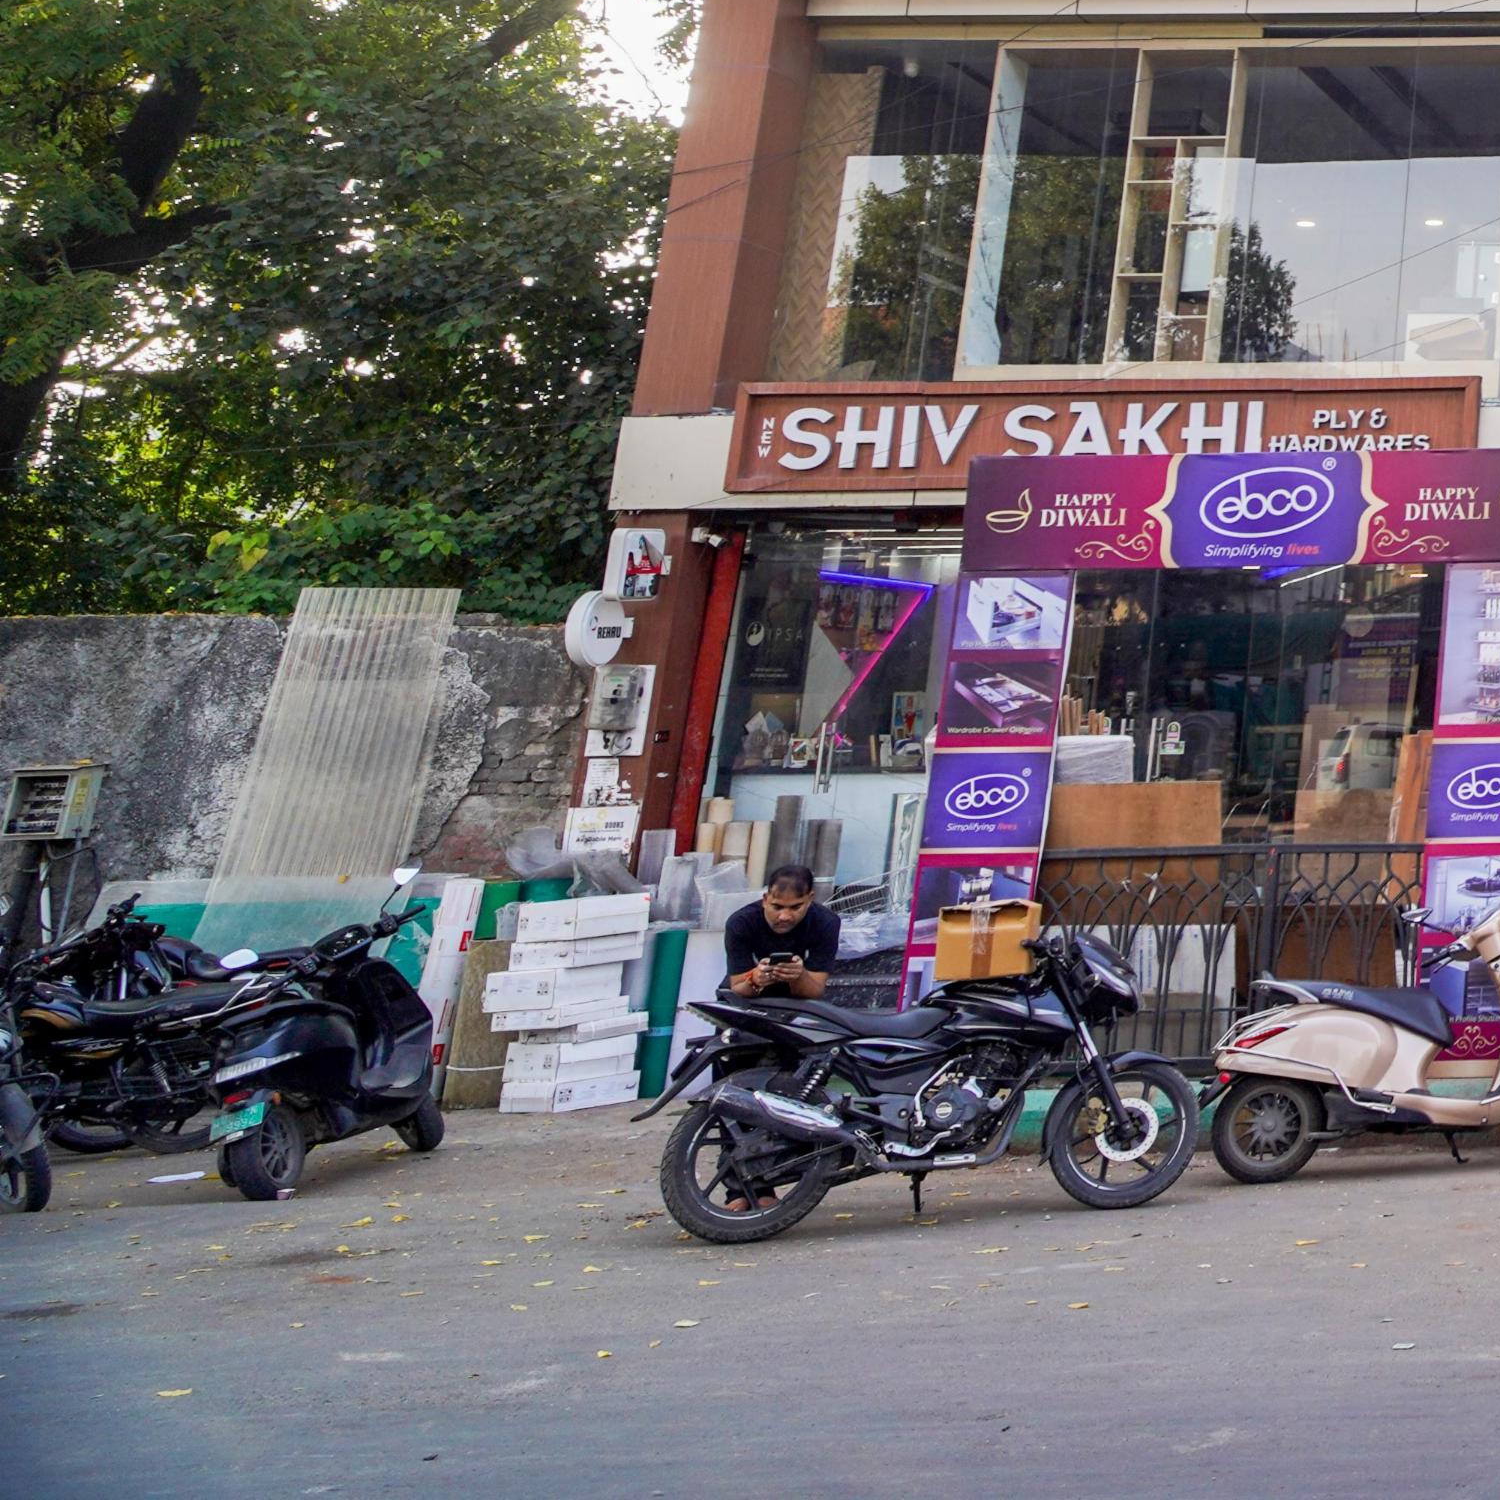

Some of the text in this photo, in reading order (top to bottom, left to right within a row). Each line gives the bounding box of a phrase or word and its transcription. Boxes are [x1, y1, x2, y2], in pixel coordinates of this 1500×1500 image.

[1312, 408, 1388, 430] PLY &
[758, 417, 776, 459] NEW
[778, 401, 1264, 471] SHIV SAKHI
[1268, 434, 1430, 452] HARDWARES
[1055, 492, 1117, 507] HAPPY
[1217, 476, 1318, 524] ebco
[1419, 486, 1479, 501] HAPPY
[1040, 507, 1127, 528] DIWALI
[1405, 501, 1490, 522] DIWALI
[1204, 543, 1320, 559] Simplifying lives
[597, 626, 622, 639] REHAU
[948, 726, 982, 734] Wardrobe
[955, 778, 1019, 810] ebco
[1450, 812, 1499, 822] Simplifying
[946, 822, 995, 833] Simplifying
